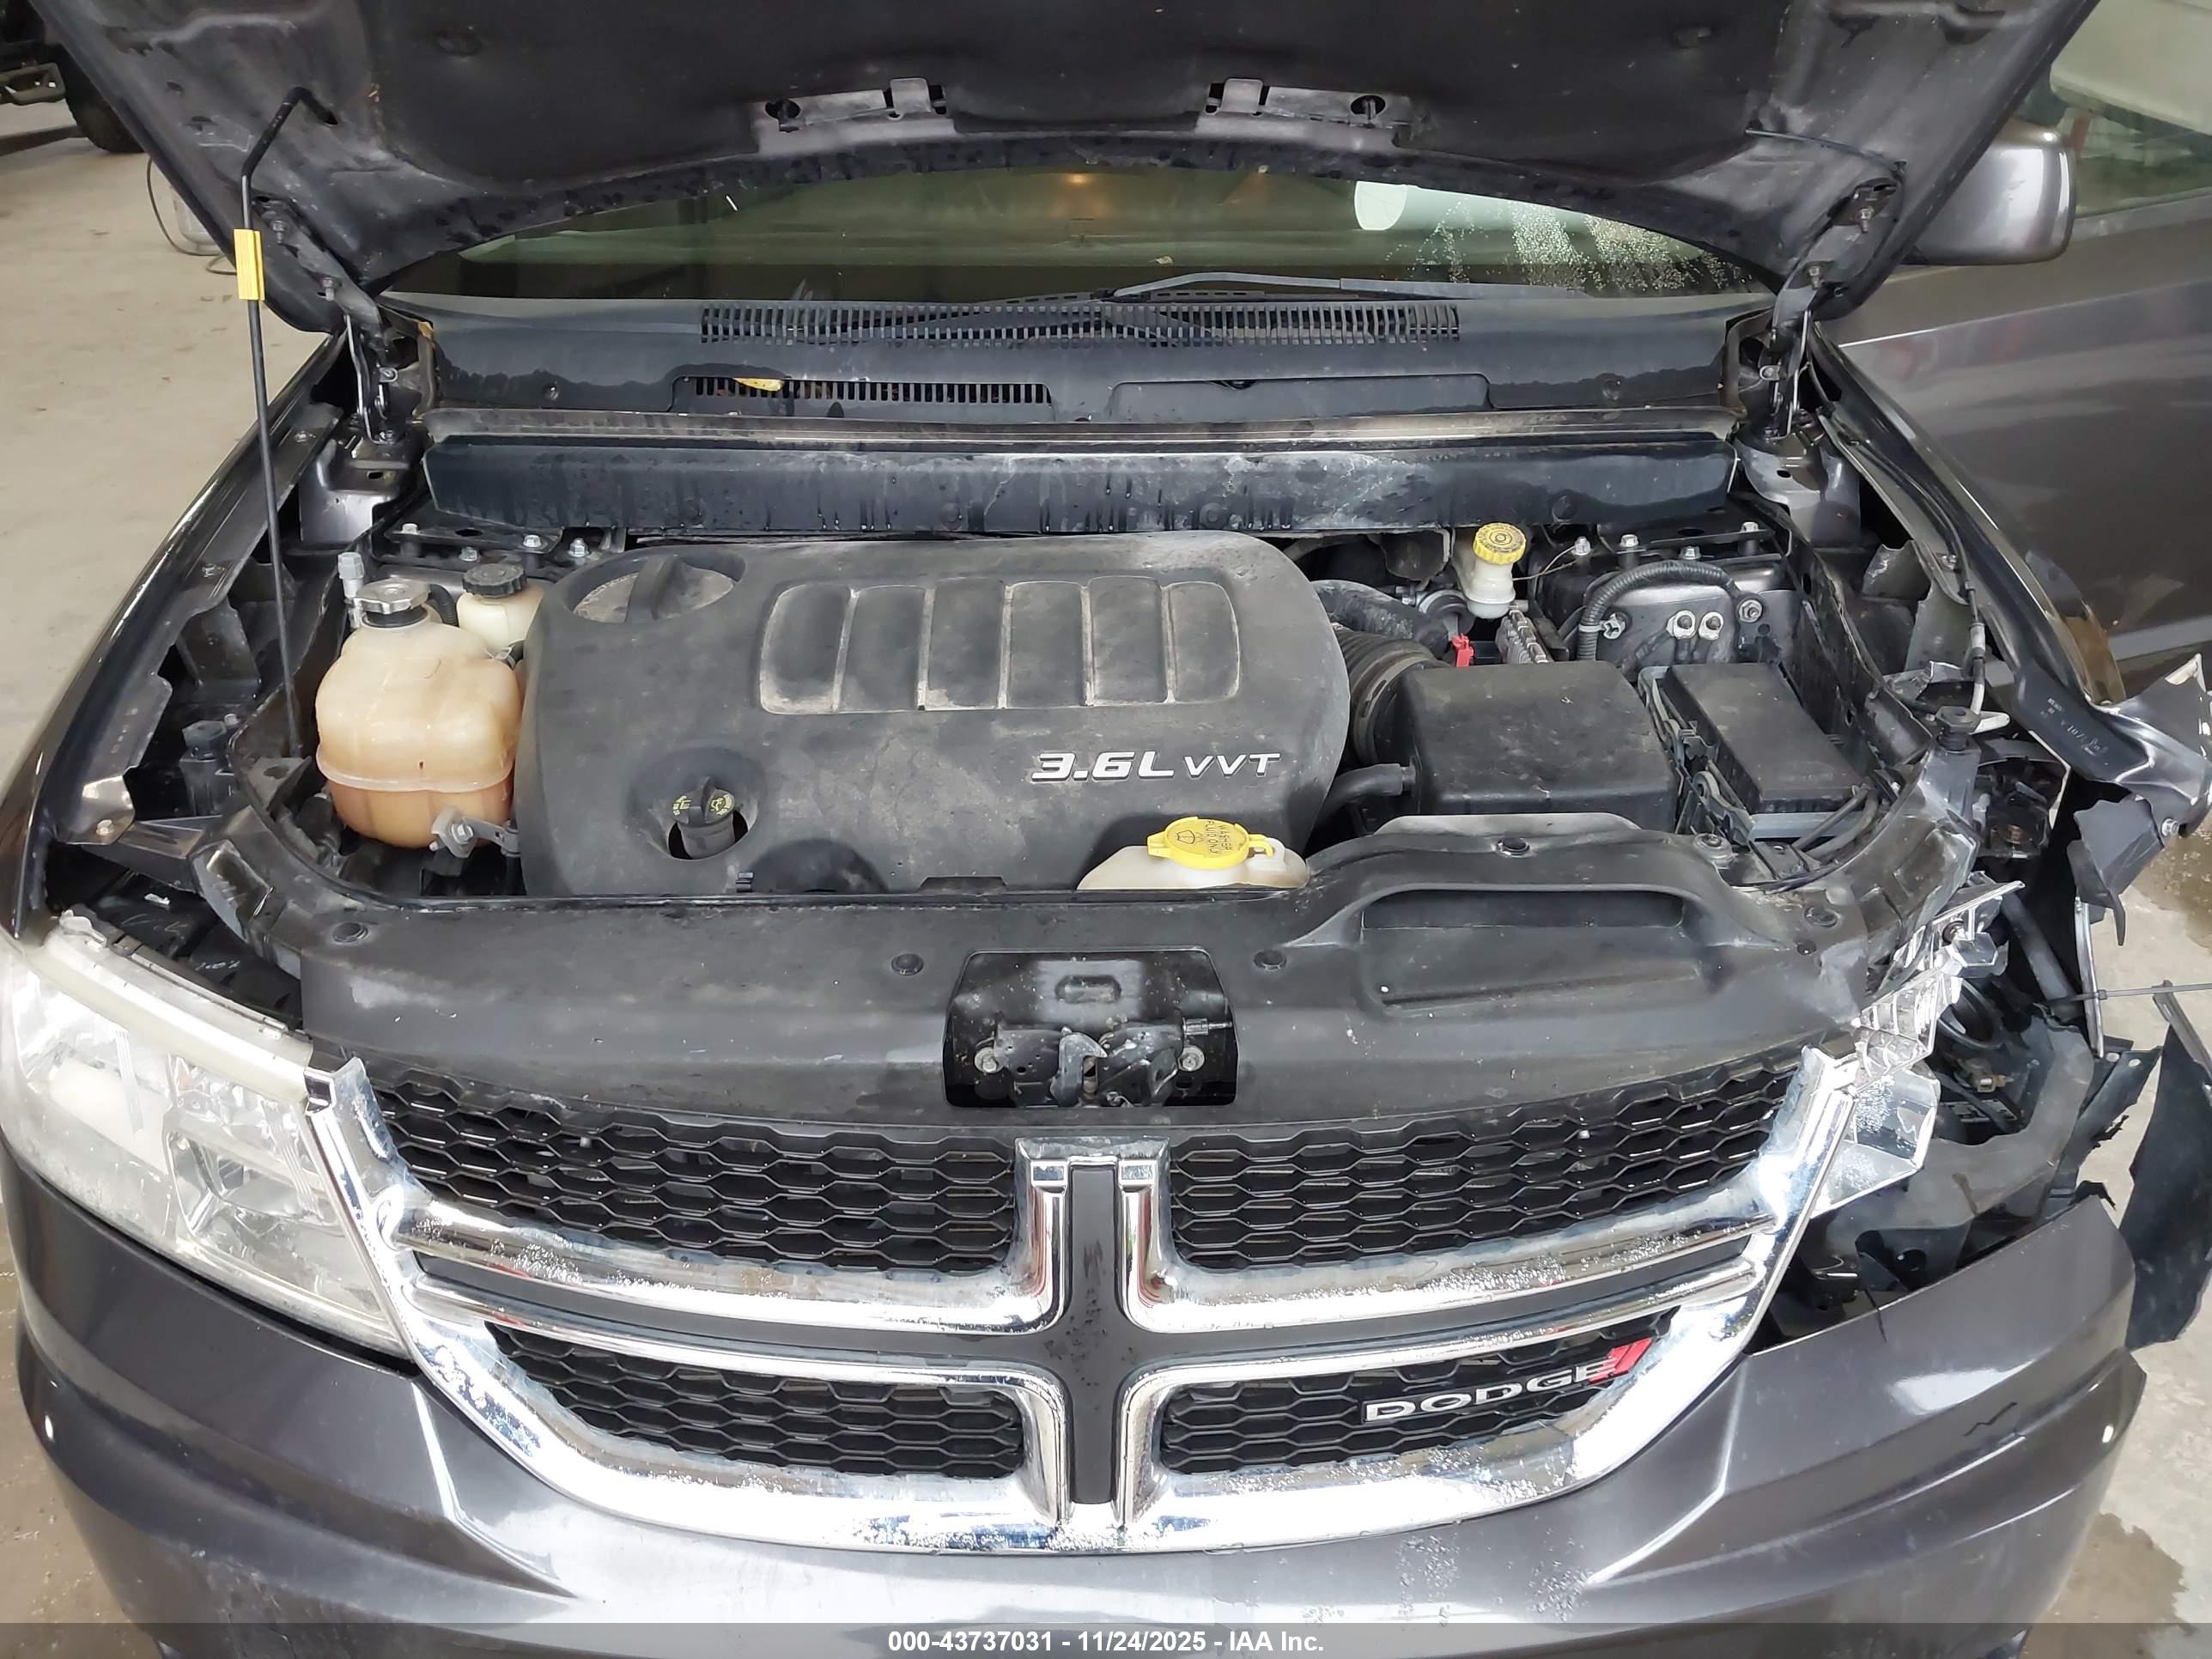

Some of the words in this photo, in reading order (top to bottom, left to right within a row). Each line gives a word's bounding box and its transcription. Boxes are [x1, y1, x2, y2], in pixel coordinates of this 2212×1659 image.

[1030, 750, 1175, 781] 3.6L
[1183, 752, 1281, 778] VVT
[1205, 820, 1217, 838] FLUID
[1217, 824, 1232, 851] WASHER
[1208, 839, 1220, 854] ONLY
[1365, 1356, 1617, 1422] DODGE
